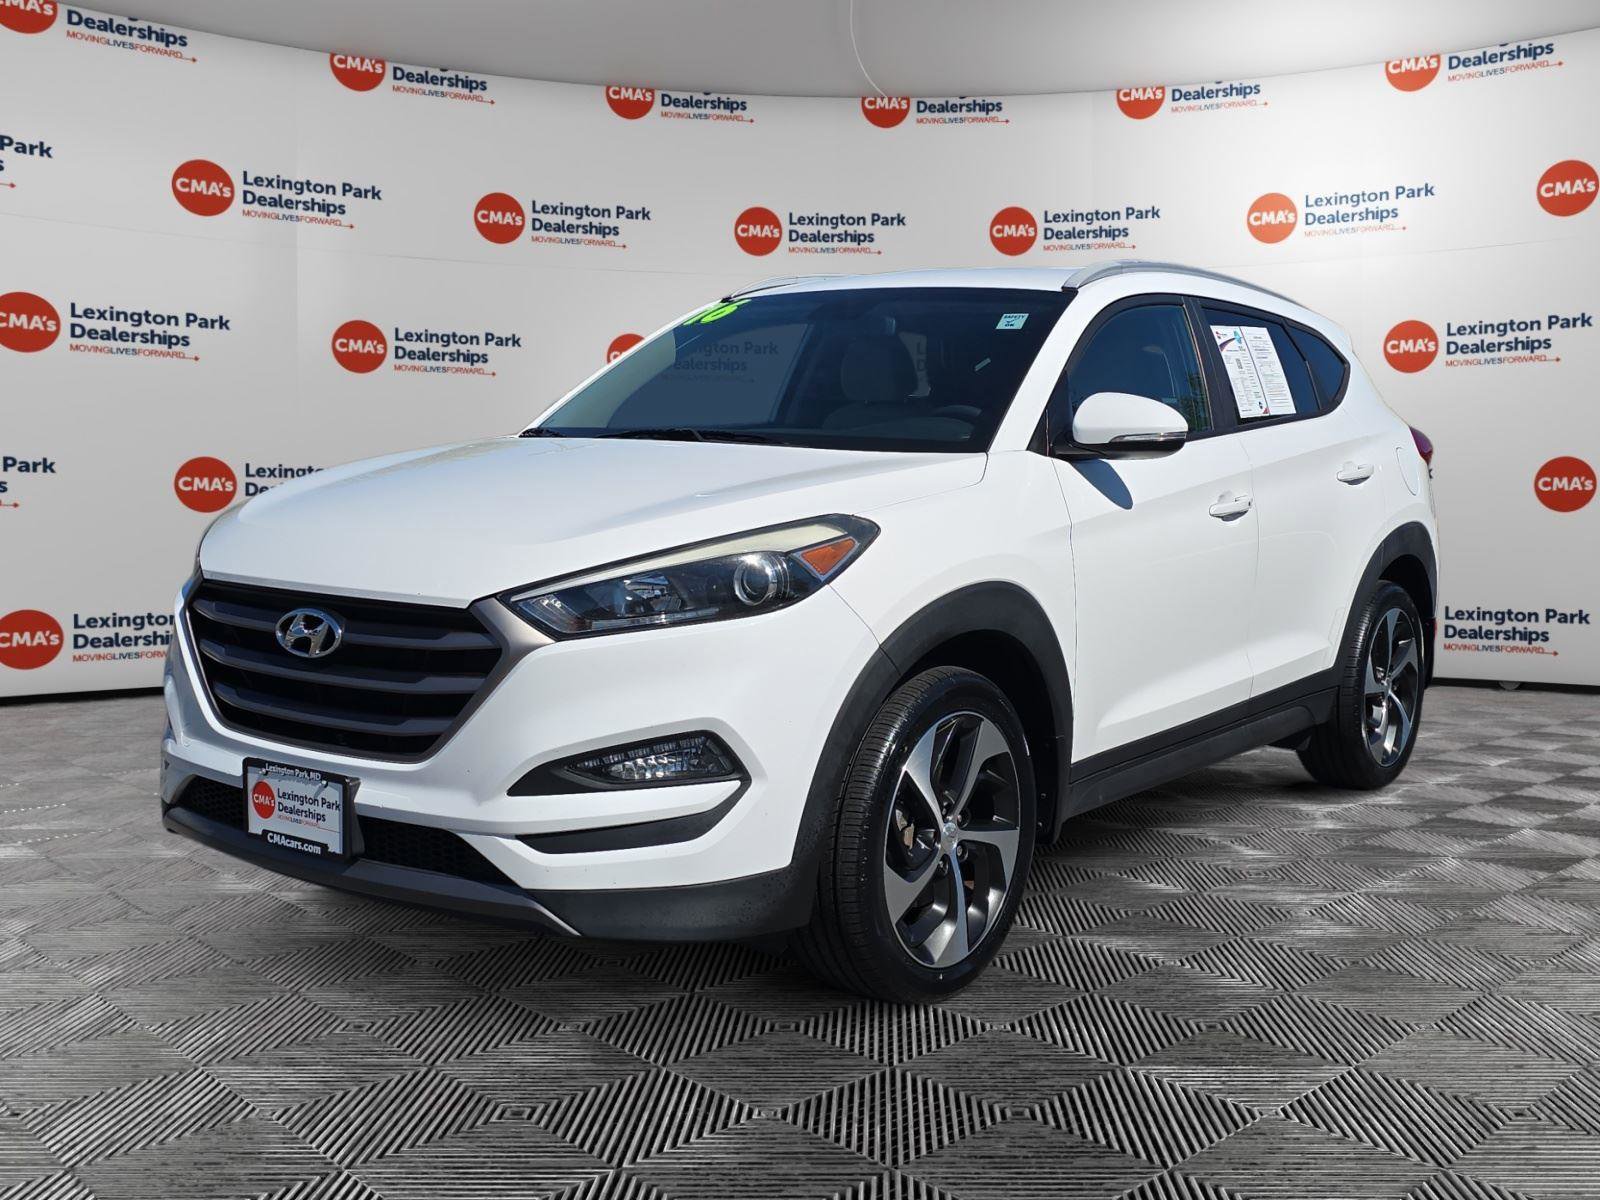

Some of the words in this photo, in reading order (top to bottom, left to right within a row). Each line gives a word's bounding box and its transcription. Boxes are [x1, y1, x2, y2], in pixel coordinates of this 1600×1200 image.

[0, 0, 54, 16] MA's
[67, 9, 188, 47] Dealerships
[333, 54, 385, 75] CMA's
[1387, 54, 1439, 75] CMA's
[1448, 42, 1554, 70] Dealerships
[393, 66, 487, 93] Dealerships
[608, 86, 653, 102] CMA's
[1119, 86, 1163, 101] CMA's
[1171, 82, 1261, 102] Dealerships
[661, 93, 747, 113] Dealerships
[864, 97, 908, 110] CMA's
[916, 100, 1002, 116] Dealerships
[0, 134, 53, 159] Park
[176, 177, 232, 198] CMA's
[242, 171, 337, 195] Lexington
[342, 183, 382, 200] Park
[1305, 188, 1390, 208] Lexington
[1395, 183, 1435, 199] Park
[1540, 178, 1596, 198] CMA's
[243, 190, 346, 216] Dealerships
[531, 200, 610, 220] Lexington
[616, 206, 651, 221] Park
[477, 209, 524, 226] CMA's
[788, 212, 866, 230] Lexington
[871, 213, 906, 226] Park
[1044, 209, 1121, 225] Lexington
[1125, 205, 1160, 220] Park
[1249, 210, 1296, 226] CMA's
[1305, 206, 1399, 227] Dealerships
[531, 218, 619, 238] Dealerships
[737, 223, 780, 238] CMA's
[788, 230, 875, 245] Dealerships
[992, 223, 1036, 238] CMA's
[1044, 225, 1129, 242] Dealerships
[70, 302, 179, 327] Lexington
[185, 313, 230, 330] Park
[1446, 317, 1541, 337] Lexington
[1548, 312, 1593, 330] Park
[70, 323, 190, 349] Dealerships
[335, 337, 386, 355] CMA's
[394, 327, 480, 347] Lexington
[485, 331, 521, 348] Park
[1446, 336, 1551, 356] Dealerships
[394, 345, 489, 366] Dealerships
[1386, 338, 1436, 355] CMA's
[2, 456, 56, 474] Park
[245, 463, 325, 479] Lexingt
[178, 475, 234, 492] CMA's
[1537, 475, 1594, 492] CMA's
[1444, 606, 1539, 627] Lexington
[1545, 608, 1590, 625] Park
[0, 630, 60, 648] CMA's
[73, 630, 173, 649] Dealershi
[1444, 624, 1550, 645] Dealerships
[265, 763, 295, 776] Lexington
[253, 793, 275, 807] CMA's
[277, 788, 319, 806] Lexington
[321, 798, 341, 811] Park
[277, 802, 326, 822] Dealerships
[267, 832, 321, 854] CMAcars.com
